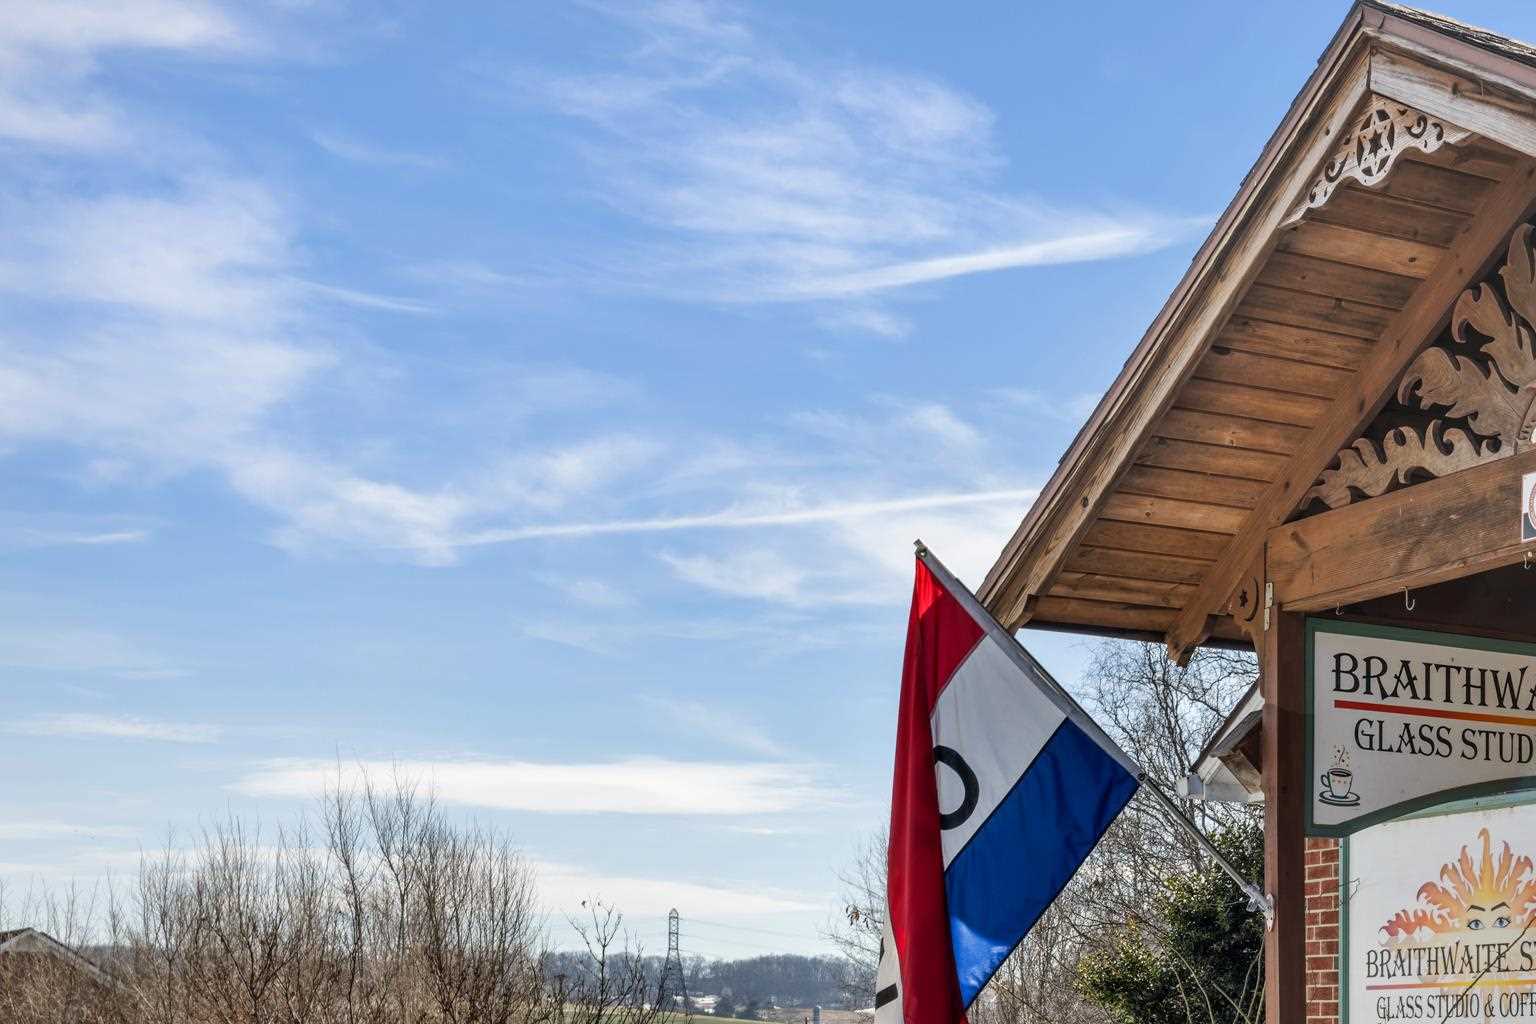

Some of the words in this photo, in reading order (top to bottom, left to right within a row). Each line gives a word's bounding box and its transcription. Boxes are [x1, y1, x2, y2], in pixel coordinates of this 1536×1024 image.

[1354, 718, 1453, 759] GLASS
[1366, 940, 1510, 979] BRAITHWAITE
[1377, 994, 1423, 1020] GLASS
[1427, 993, 1479, 1019] STUDIO
[1484, 995, 1495, 1017] &
